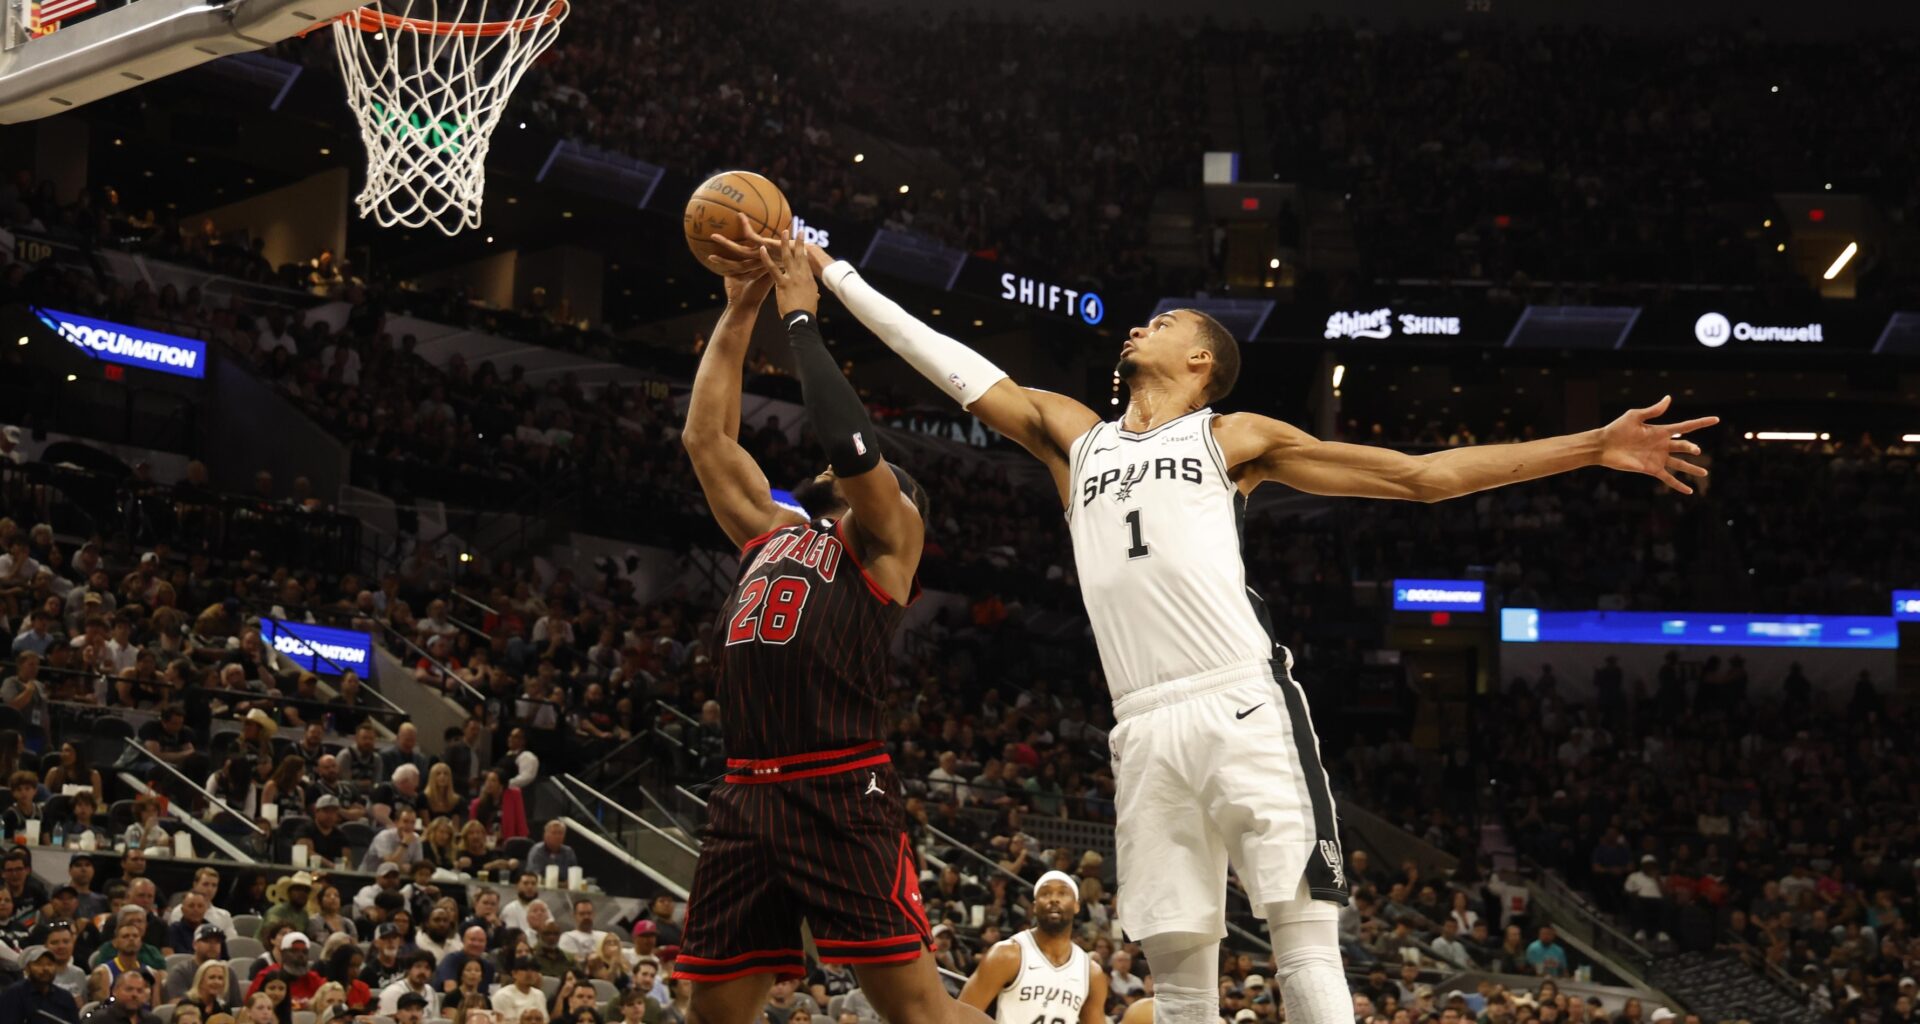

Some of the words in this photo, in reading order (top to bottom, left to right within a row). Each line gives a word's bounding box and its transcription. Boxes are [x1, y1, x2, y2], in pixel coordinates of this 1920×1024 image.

[1733, 322, 1823, 342] Ownwell
[1083, 457, 1203, 508] SPURS
[1124, 507, 1151, 562] 1
[726, 575, 811, 647] 28
[1019, 985, 1082, 1011] SPURS
